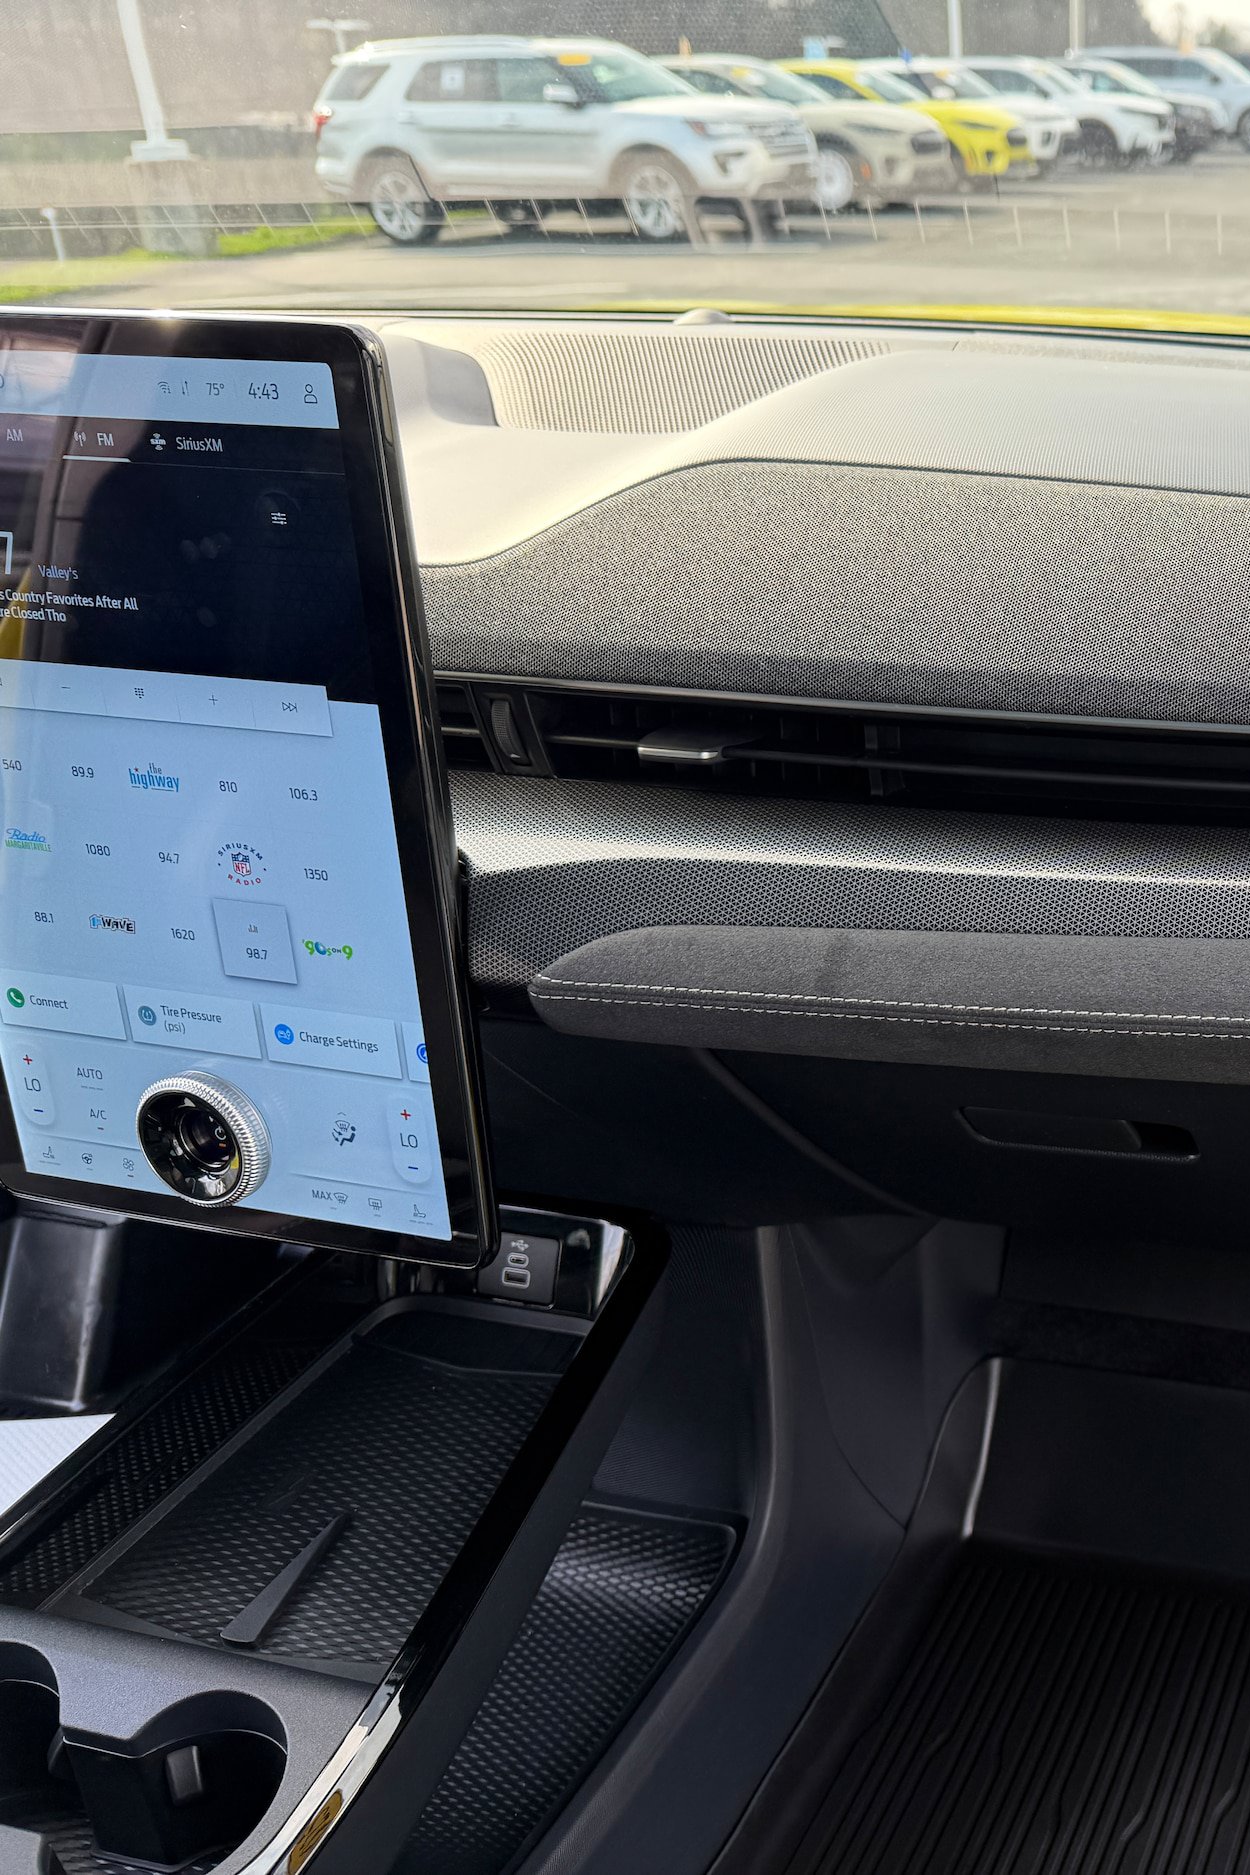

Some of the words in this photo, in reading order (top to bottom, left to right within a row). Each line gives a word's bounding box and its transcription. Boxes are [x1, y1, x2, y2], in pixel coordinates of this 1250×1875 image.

[206, 382, 224, 396] 75°
[248, 382, 279, 400] 4:43
[6, 428, 24, 442] AM
[96, 432, 114, 447] FM
[175, 436, 223, 452] SiriusXM
[38, 564, 79, 581] Valley's
[5, 588, 46, 606] Country
[45, 591, 95, 608] Favorites
[95, 595, 122, 610] After
[123, 597, 139, 611] All
[11, 606, 46, 621] Closed
[45, 608, 67, 622] Tho
[2, 758, 22, 771] 540
[149, 762, 162, 775] the
[71, 765, 94, 779] 89.9
[128, 767, 179, 792] highway
[219, 780, 238, 793] 810
[289, 787, 318, 801] 106.3
[6, 827, 47, 843] Radio
[85, 843, 111, 857] 1080
[158, 851, 180, 864] 94.7
[233, 862, 250, 873] NFL
[304, 868, 328, 881] 1350
[227, 873, 262, 886] RADIO
[34, 911, 54, 924] 88.1
[171, 927, 195, 941] 1620
[246, 947, 268, 960] 98.7
[29, 995, 69, 1010] Connect
[160, 1004, 179, 1018] Tire
[181, 1008, 222, 1024] Pressure
[164, 1020, 186, 1035] (psi)
[299, 1031, 335, 1048] Charge
[336, 1036, 379, 1053] Settings
[76, 1066, 103, 1080] AUTO
[24, 1076, 42, 1093] LO
[89, 1108, 107, 1121] A/C
[400, 1132, 419, 1149] LO
[311, 1188, 333, 1202] MAX
